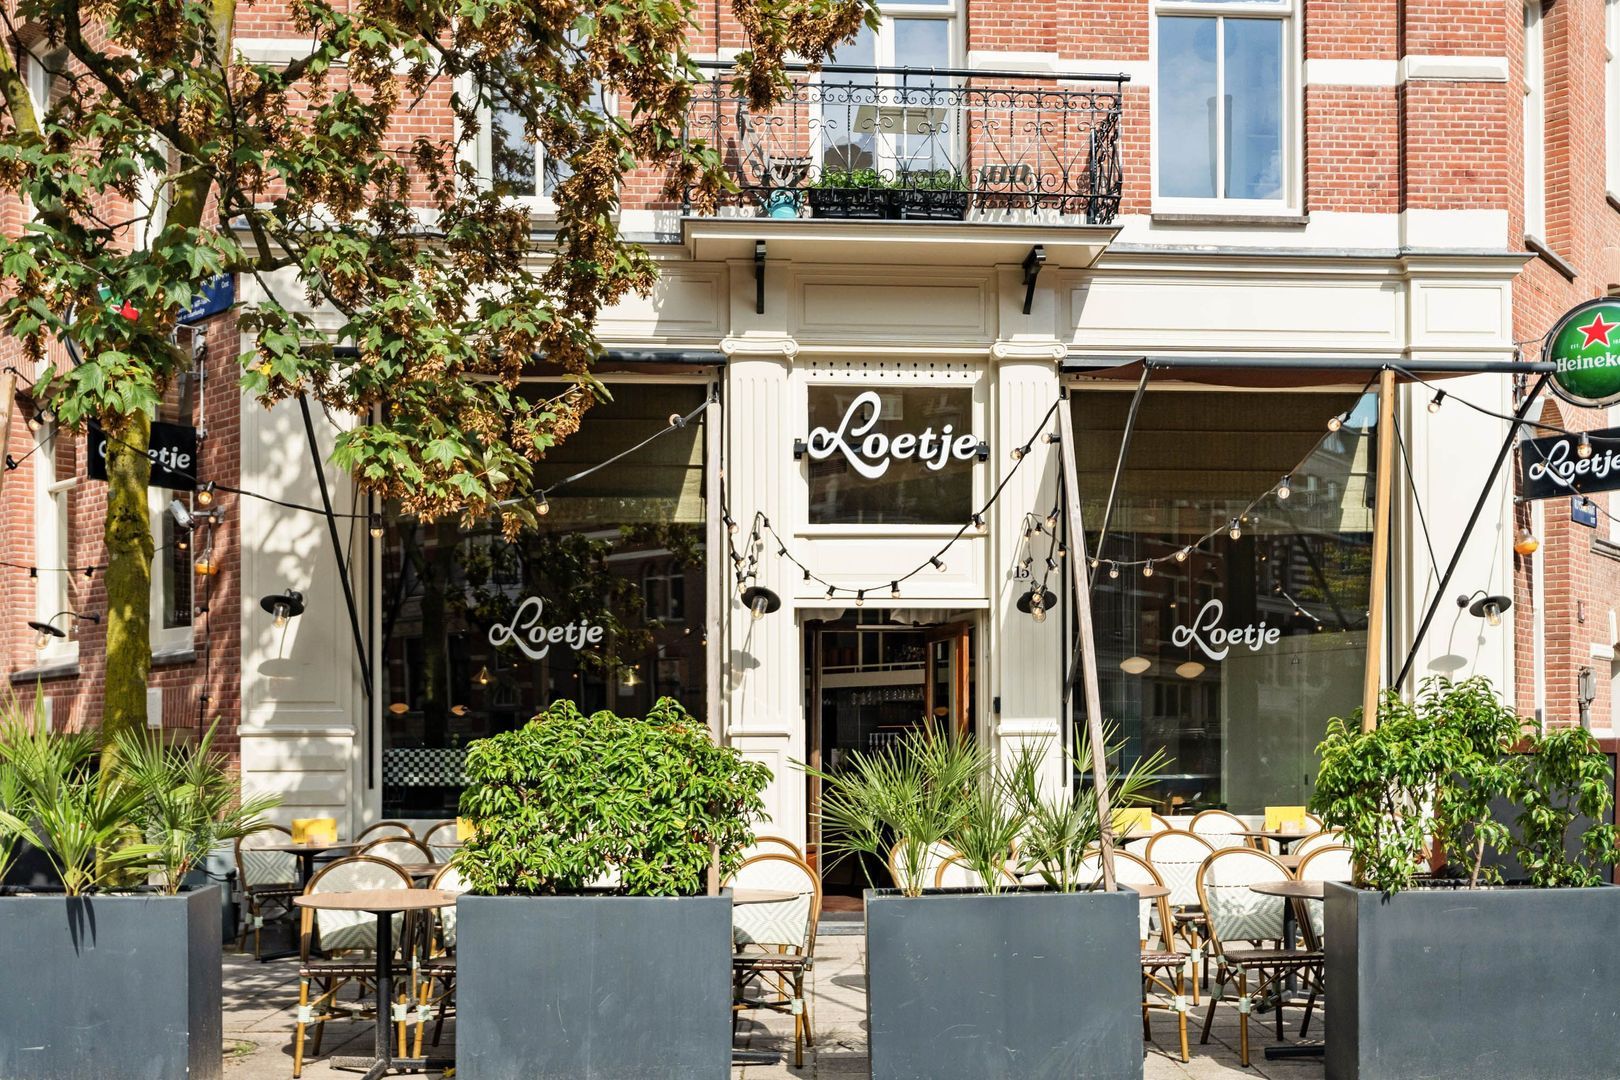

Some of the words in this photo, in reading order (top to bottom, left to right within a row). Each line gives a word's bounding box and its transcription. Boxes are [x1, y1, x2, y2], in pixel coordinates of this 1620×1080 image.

[807, 390, 979, 479] Loetje
[1014, 565, 1030, 579] 15
[488, 596, 604, 660] Loetje
[1172, 598, 1280, 661] Loetje
